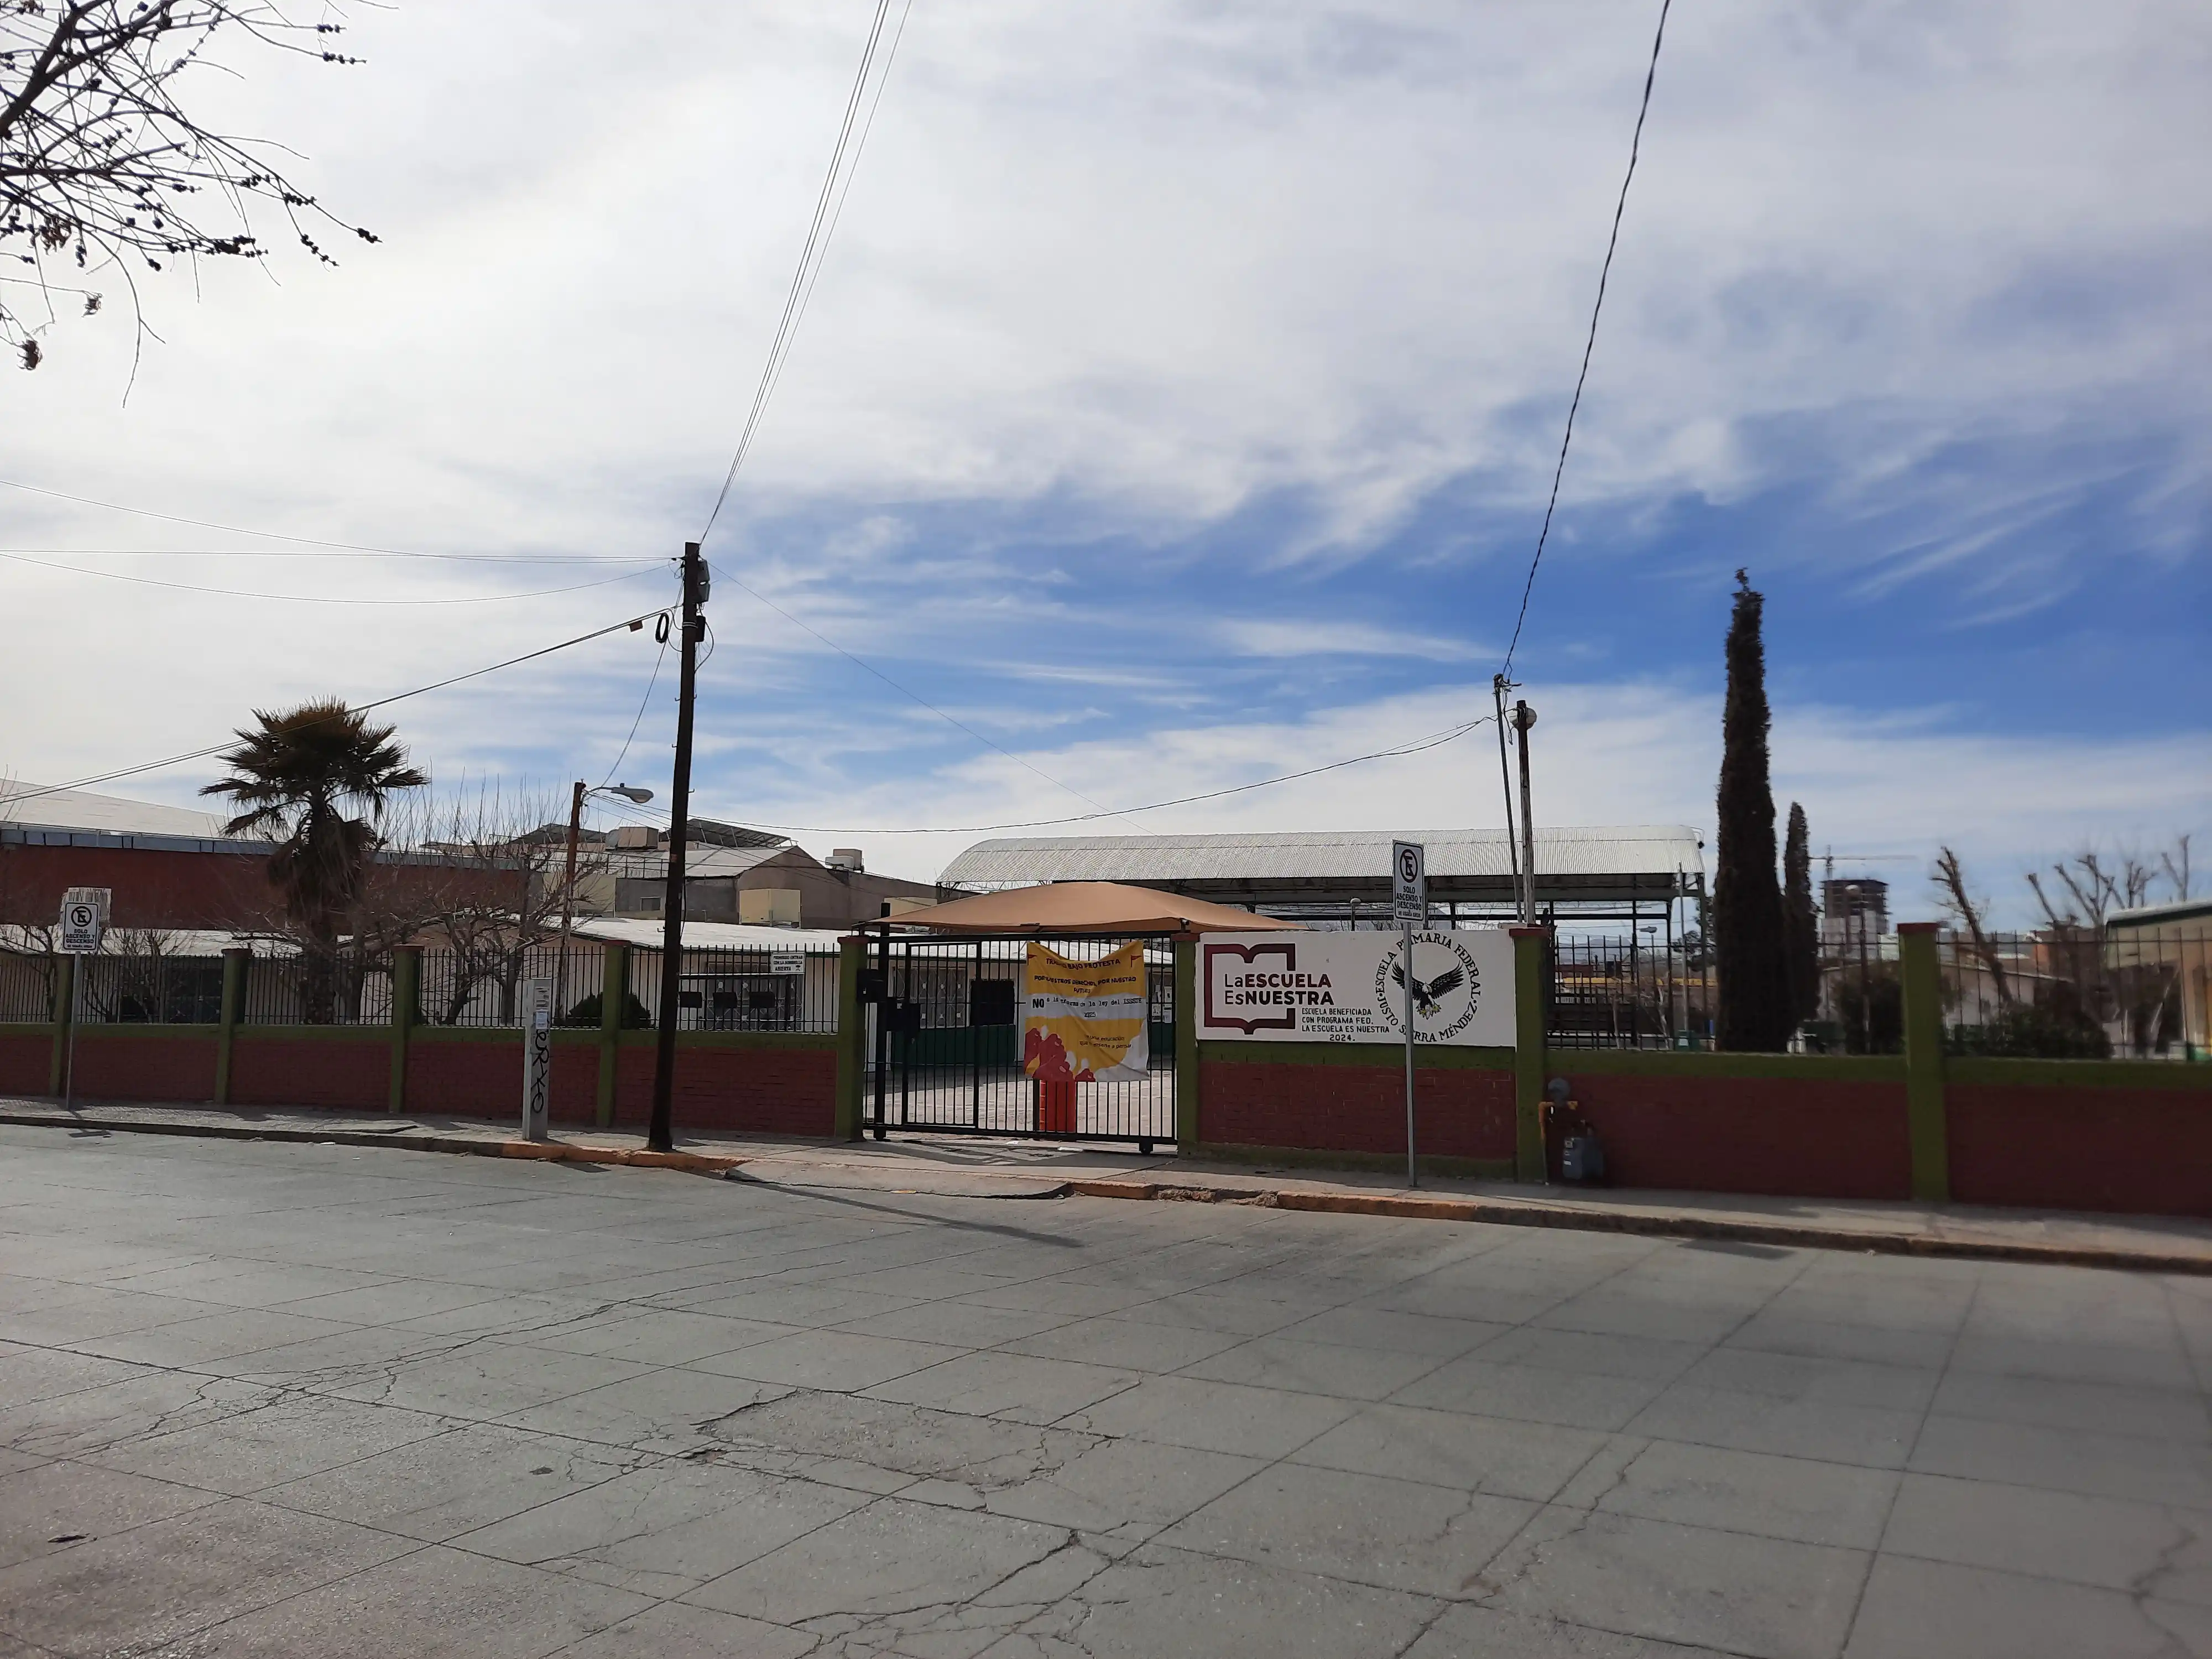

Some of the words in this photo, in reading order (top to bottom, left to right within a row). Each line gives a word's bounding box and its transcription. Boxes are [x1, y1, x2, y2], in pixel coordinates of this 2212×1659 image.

[1403, 885, 1415, 894] SOLO
[1396, 893, 1418, 902] ASCENSO
[1397, 901, 1422, 910] DESCENSO
[1084, 958, 1121, 969] PROTESTA
[1375, 951, 1397, 994] ESCUELA
[1453, 943, 1481, 999] FEDERAL
[1032, 998, 1045, 1009] NO
[1378, 995, 1399, 1026] JUSTO
[1438, 1001, 1478, 1041] MÉNDEZ
